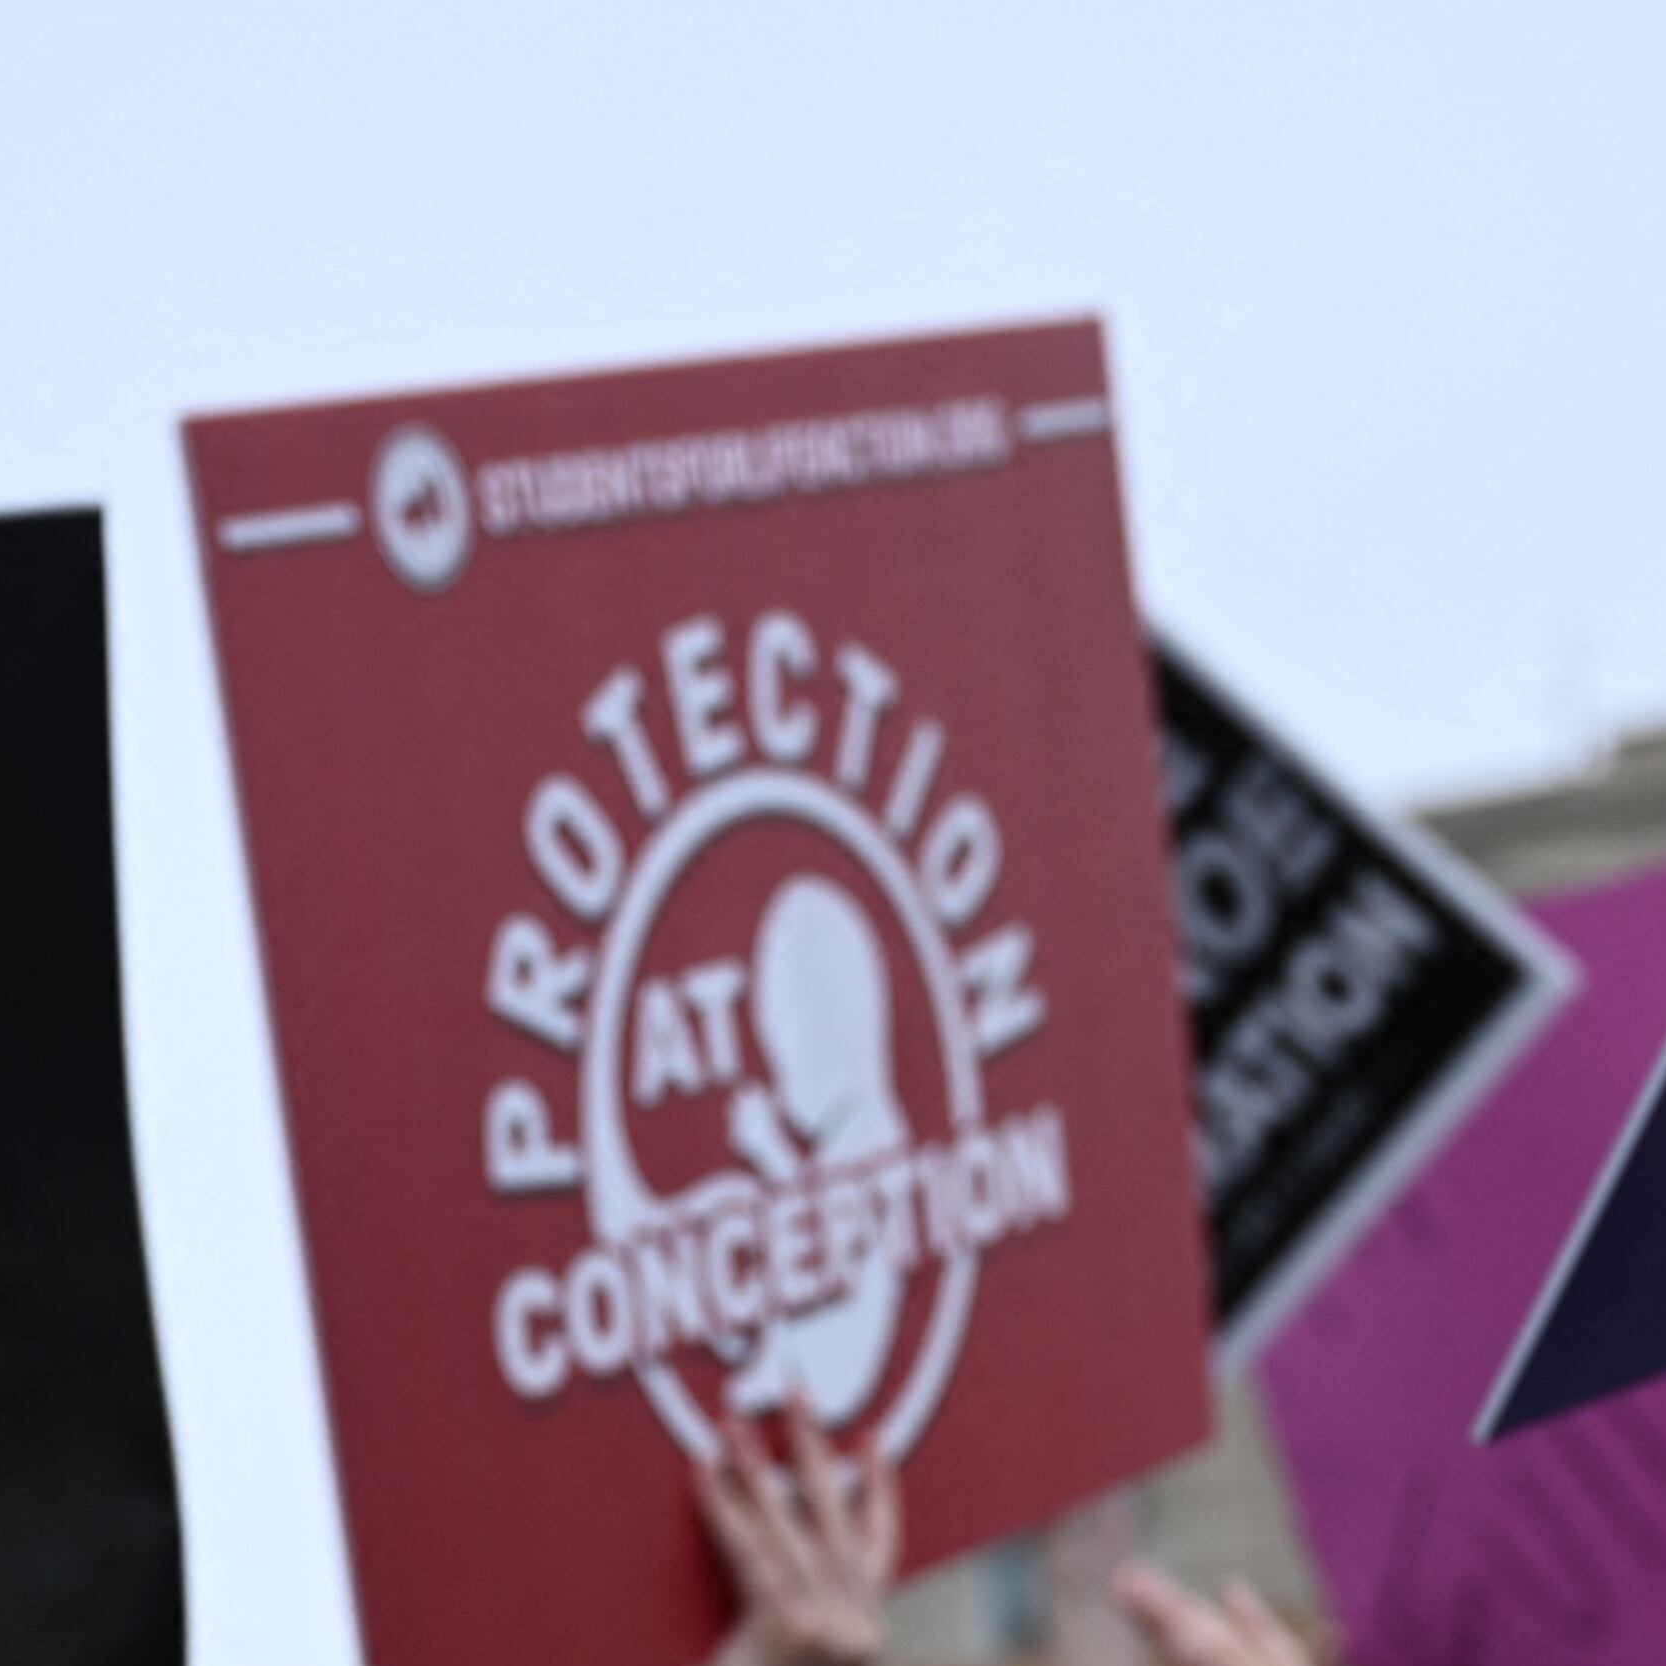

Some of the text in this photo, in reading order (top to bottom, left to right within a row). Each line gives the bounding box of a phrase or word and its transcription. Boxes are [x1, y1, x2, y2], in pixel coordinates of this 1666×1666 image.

[483, 608, 1046, 1192] PROTECTION
[633, 958, 745, 1106] AT
[492, 1104, 1071, 1399] CONCEPTION
